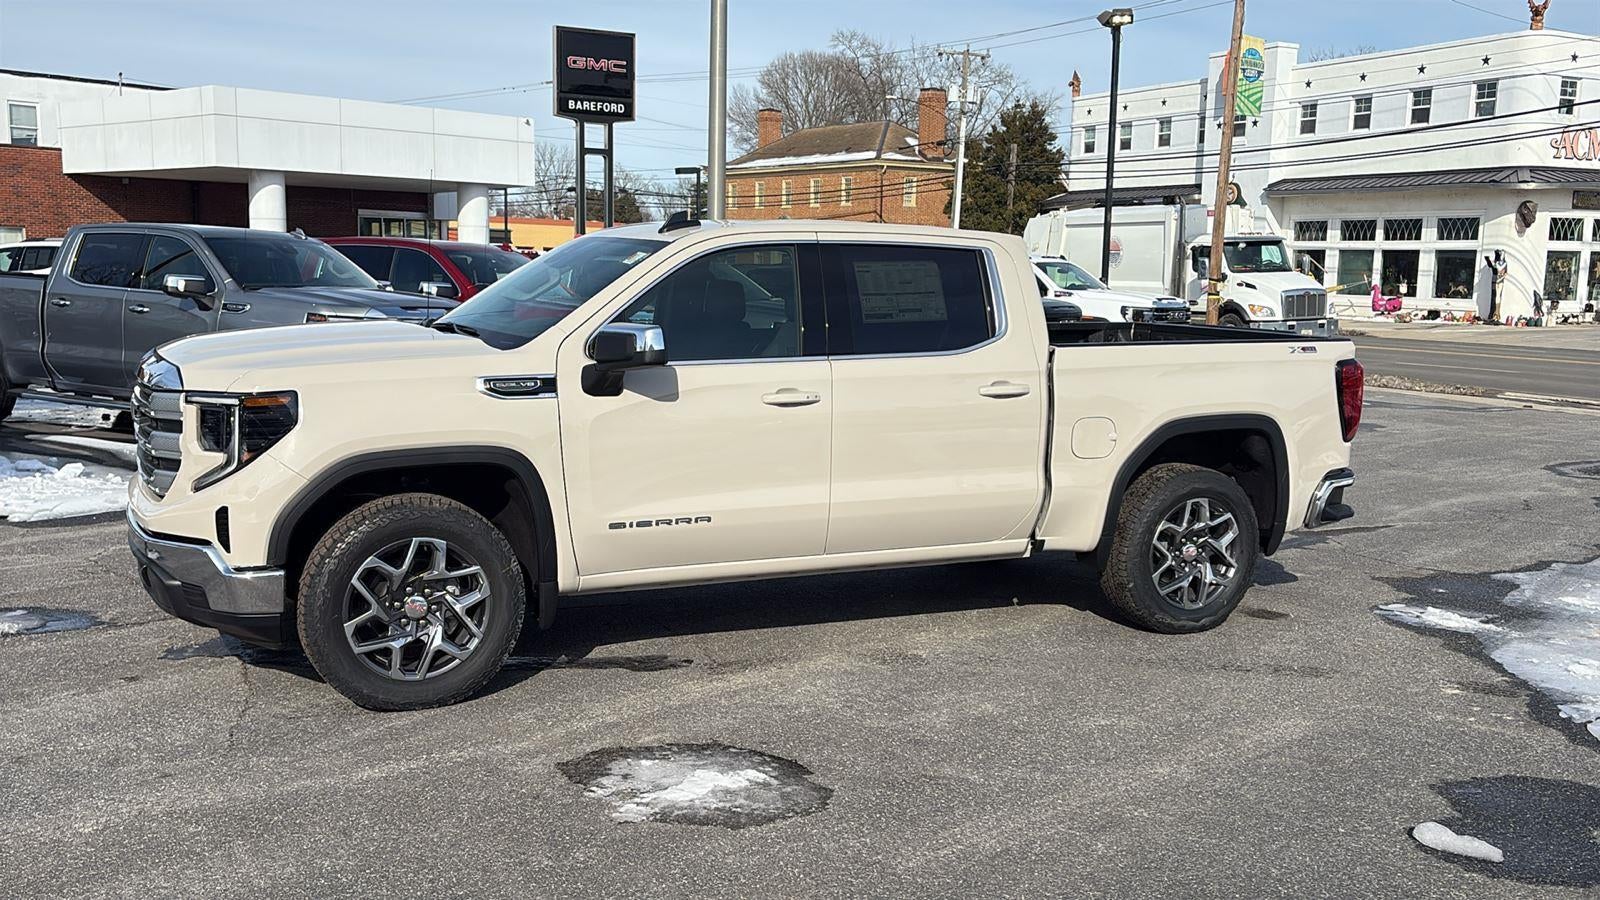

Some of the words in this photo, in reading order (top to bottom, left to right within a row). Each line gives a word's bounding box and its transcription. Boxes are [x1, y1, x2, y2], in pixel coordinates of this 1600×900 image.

[567, 56, 627, 73] GMC
[568, 100, 625, 113] BAREFORD
[608, 516, 712, 530] SIERRA
